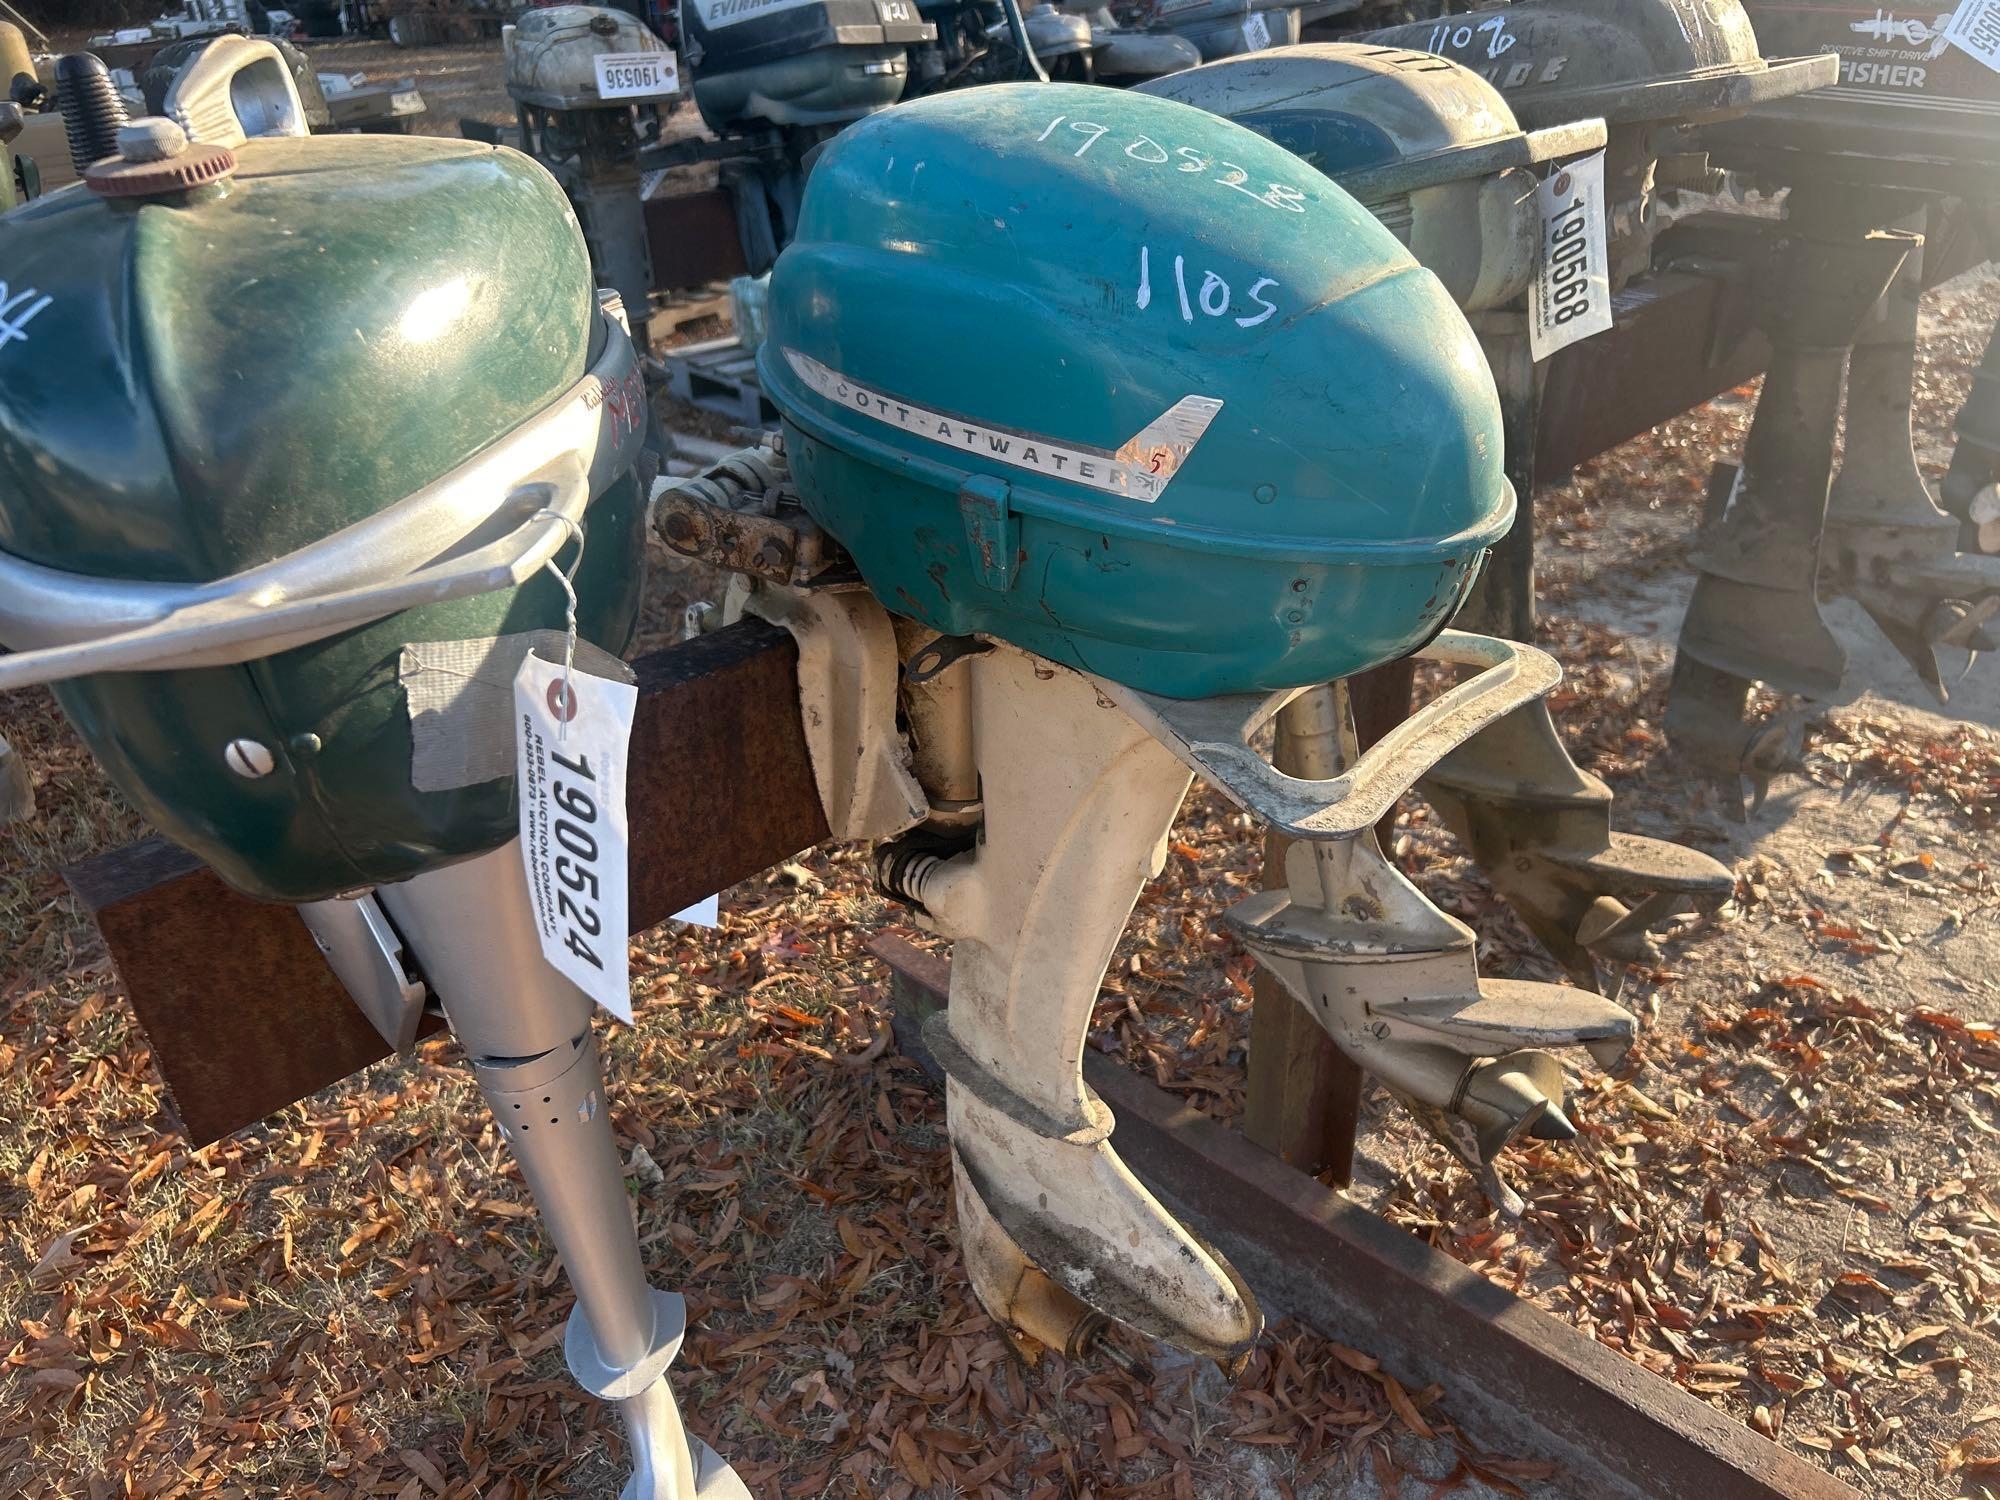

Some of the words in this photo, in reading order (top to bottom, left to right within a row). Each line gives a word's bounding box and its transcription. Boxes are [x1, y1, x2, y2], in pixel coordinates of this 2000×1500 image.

[606, 66, 661, 90] 190536
[1867, 47, 1898, 59] SHIFT
[1899, 50, 1931, 62] DRIVE
[1036, 116, 1306, 213] 190528
[1136, 246, 1280, 328] 1105
[1551, 197, 1590, 326] 190568
[533, 733, 546, 784] REBEL
[538, 787, 550, 860] AUCTION
[551, 751, 604, 970] 190524
[541, 863, 557, 934] COMPANY
